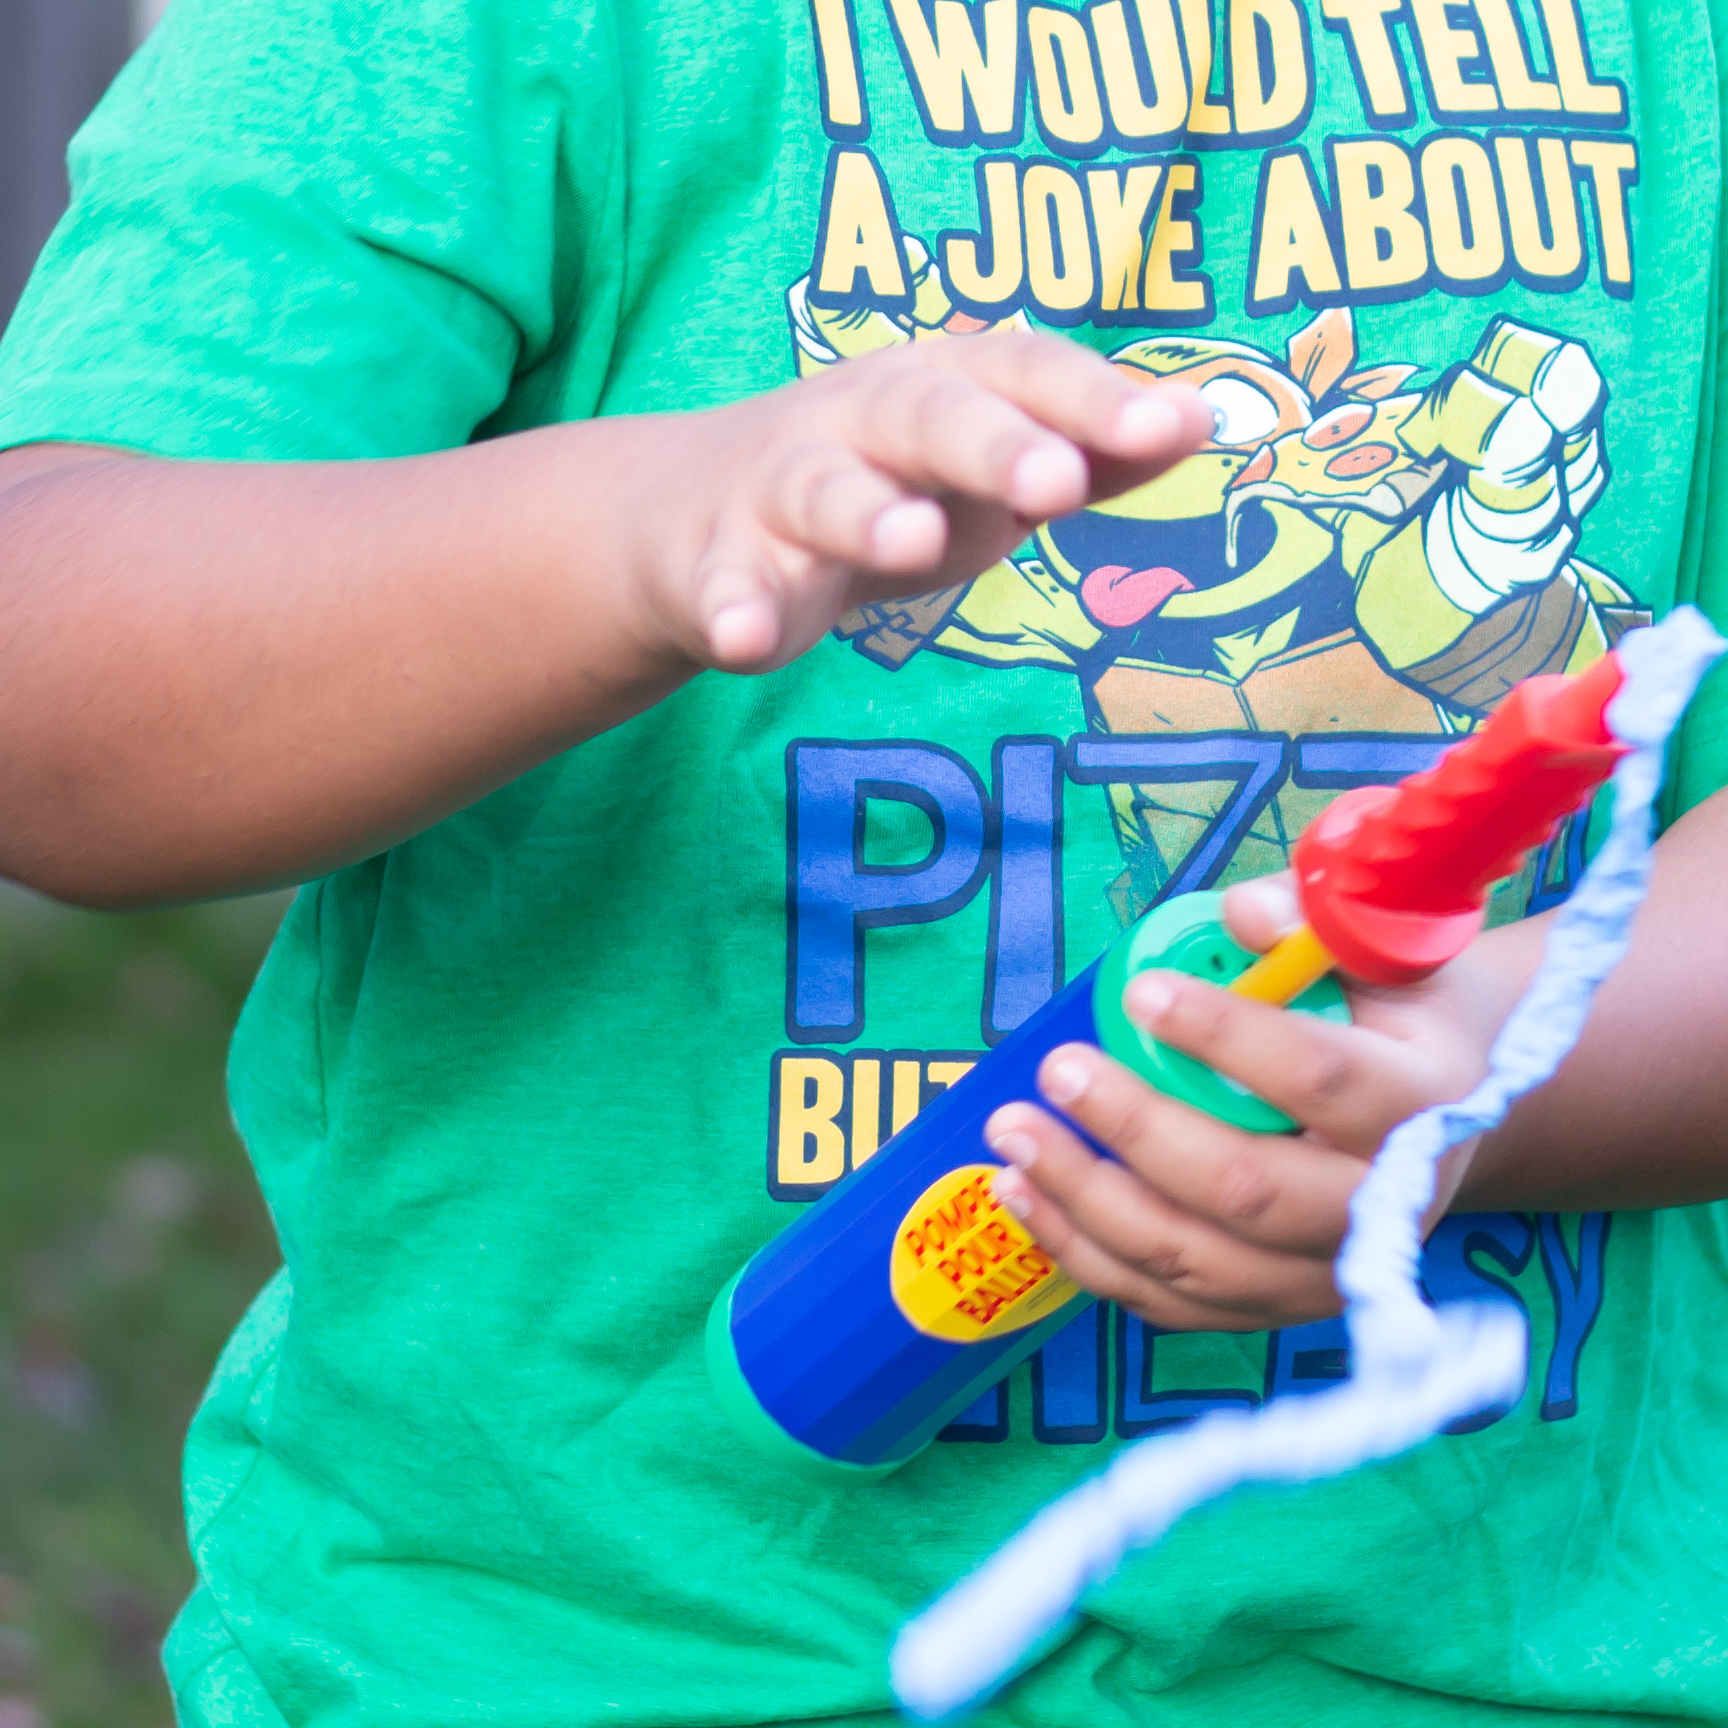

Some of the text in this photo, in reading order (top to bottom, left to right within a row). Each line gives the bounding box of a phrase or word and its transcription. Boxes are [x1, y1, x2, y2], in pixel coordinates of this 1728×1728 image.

[810, 131, 1639, 327] A JOKE ABOUT
[785, 731, 1592, 1044] PIZ
[937, 1221, 1024, 1292] POUR
[953, 1242, 1057, 1326] BALLO
